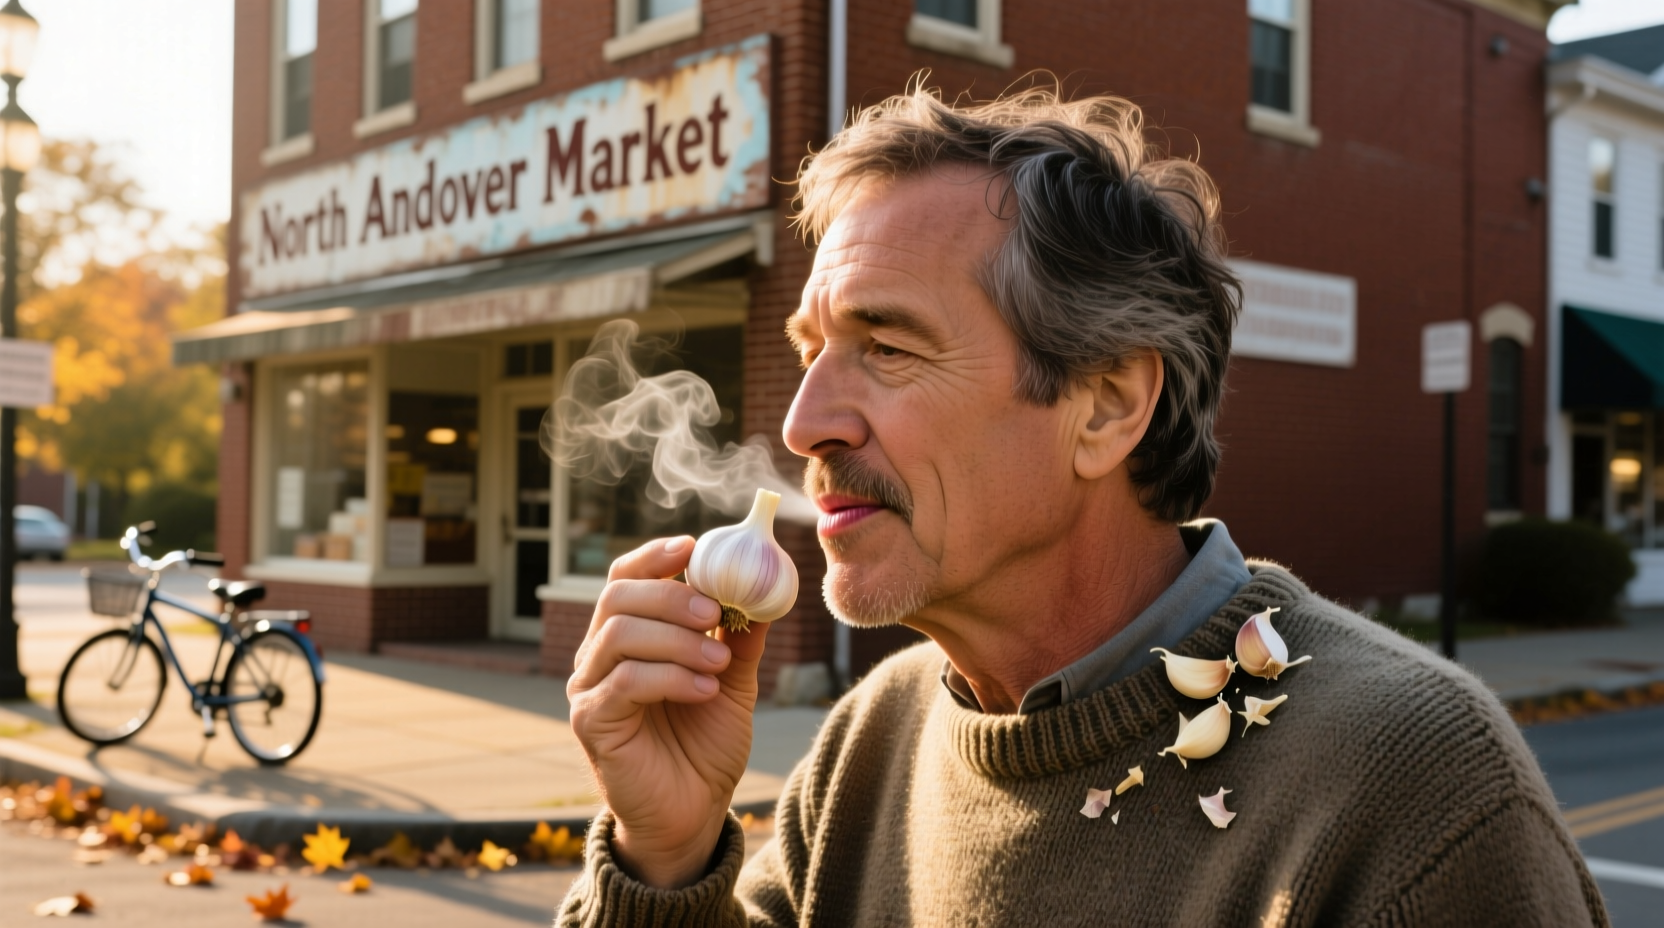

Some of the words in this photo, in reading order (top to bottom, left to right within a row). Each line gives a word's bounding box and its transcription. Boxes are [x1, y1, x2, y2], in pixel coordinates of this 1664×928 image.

[259, 189, 347, 265] North
[360, 158, 527, 243] Andover
[544, 95, 729, 203] Market
